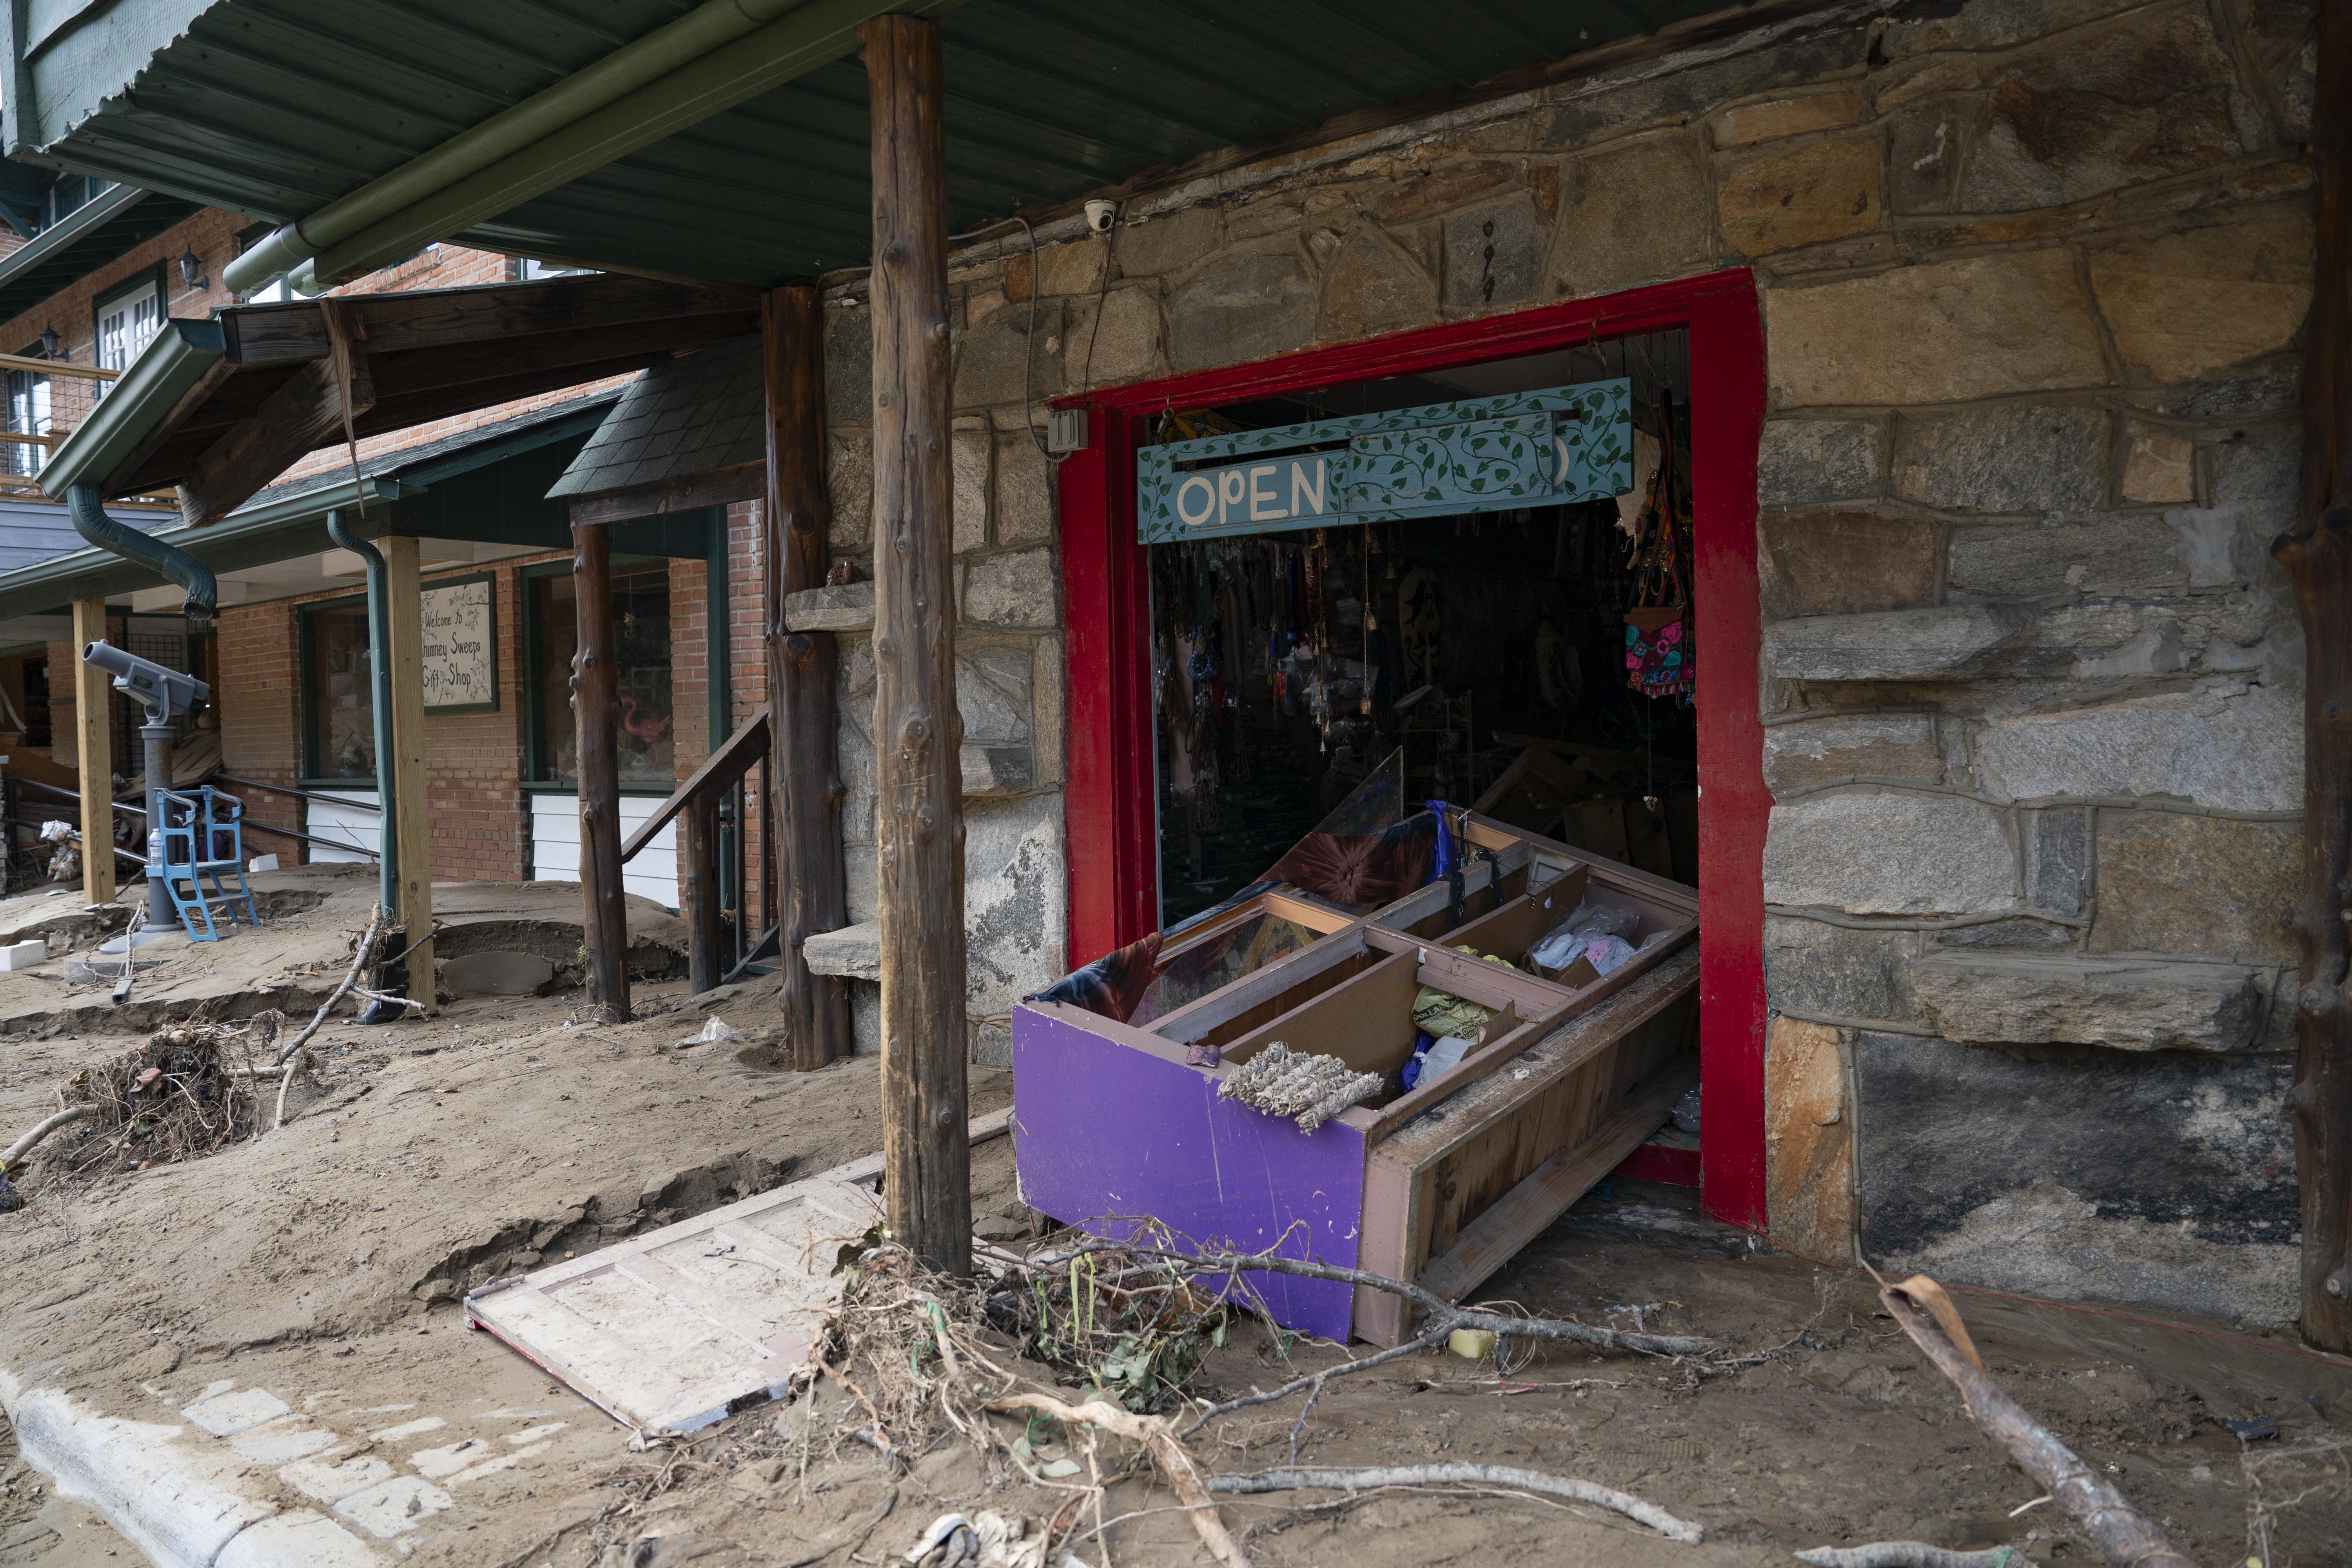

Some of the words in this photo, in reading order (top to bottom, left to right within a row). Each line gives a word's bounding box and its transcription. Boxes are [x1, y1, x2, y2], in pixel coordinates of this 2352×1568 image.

[1177, 459, 1324, 525] OPEN
[425, 609, 451, 628] Welcome
[455, 608, 462, 624] to
[423, 635, 447, 662] himney
[451, 632, 481, 661] Sweeps
[423, 665, 439, 693] Gift
[448, 662, 470, 693] Shop
